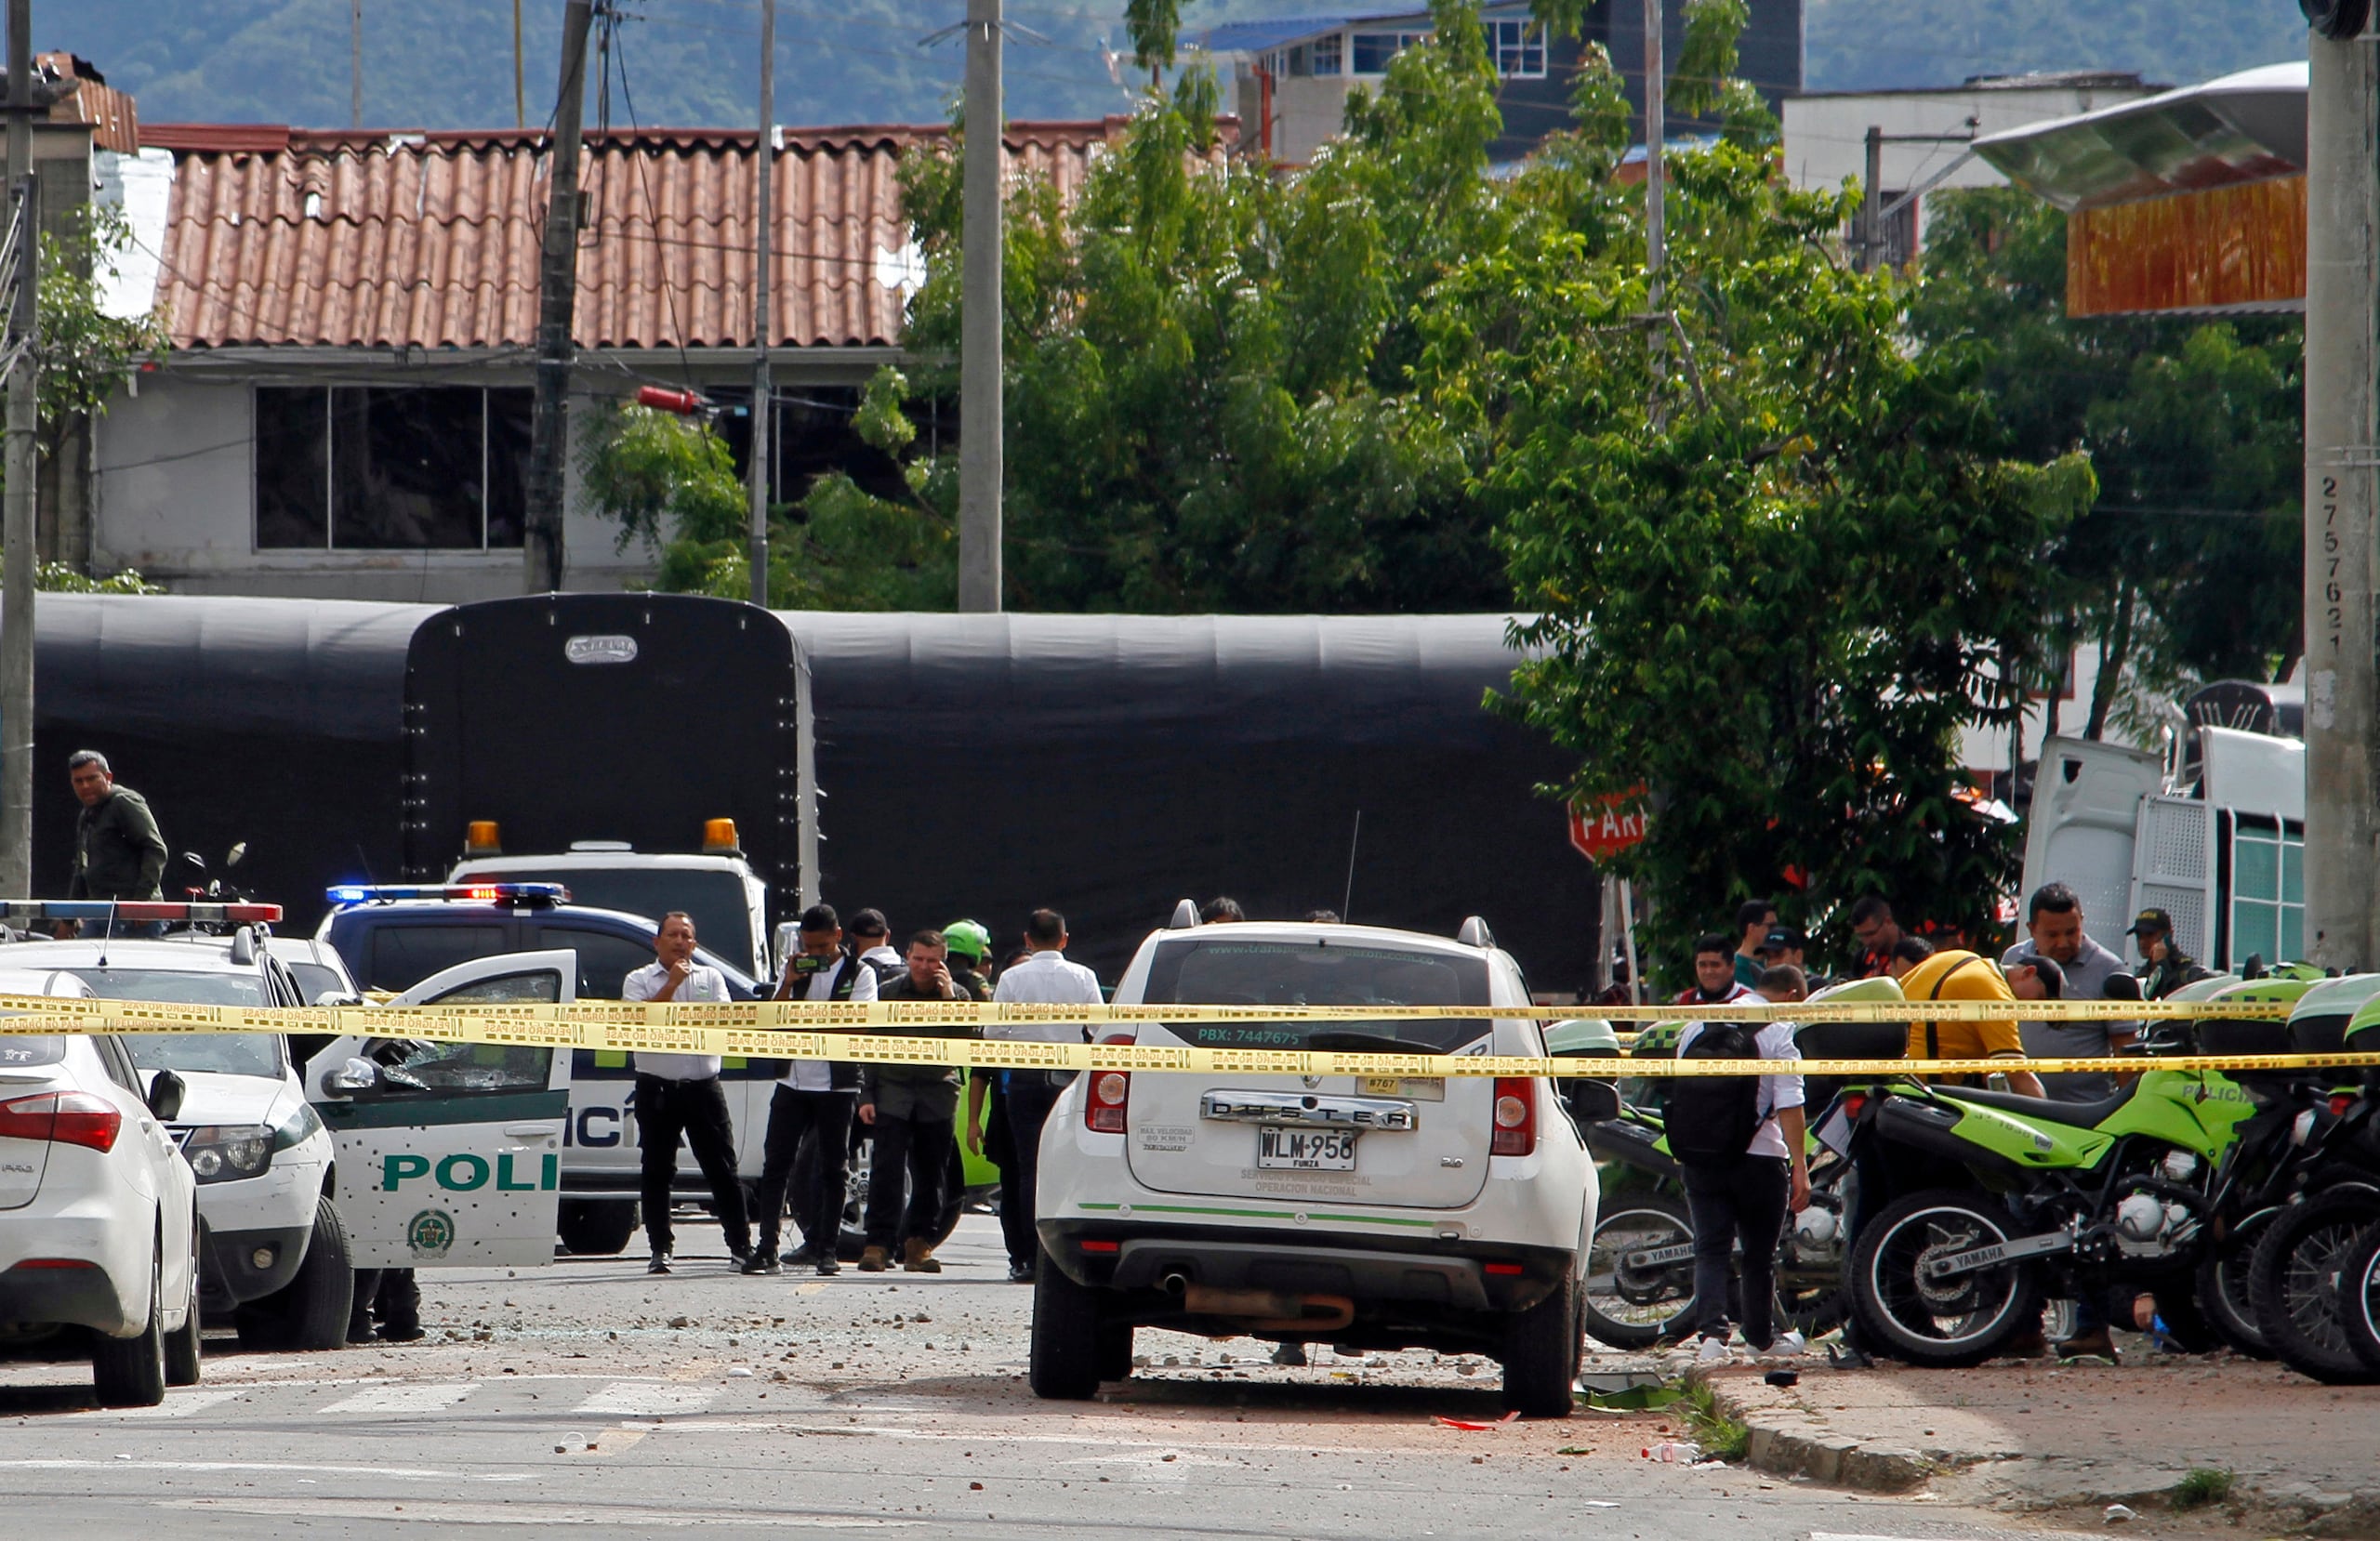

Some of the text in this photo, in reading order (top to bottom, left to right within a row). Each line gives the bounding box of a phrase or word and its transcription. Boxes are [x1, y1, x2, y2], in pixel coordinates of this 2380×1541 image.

[1198, 1028, 1300, 1045] PBX: 7447675
[1369, 1079, 1395, 1088] #767
[1212, 1103, 1407, 1126] DUSTER
[383, 1153, 557, 1192] POLI
[1293, 1159, 1319, 1168] FUNZA
[1957, 1247, 2006, 1267] YAMAHA
